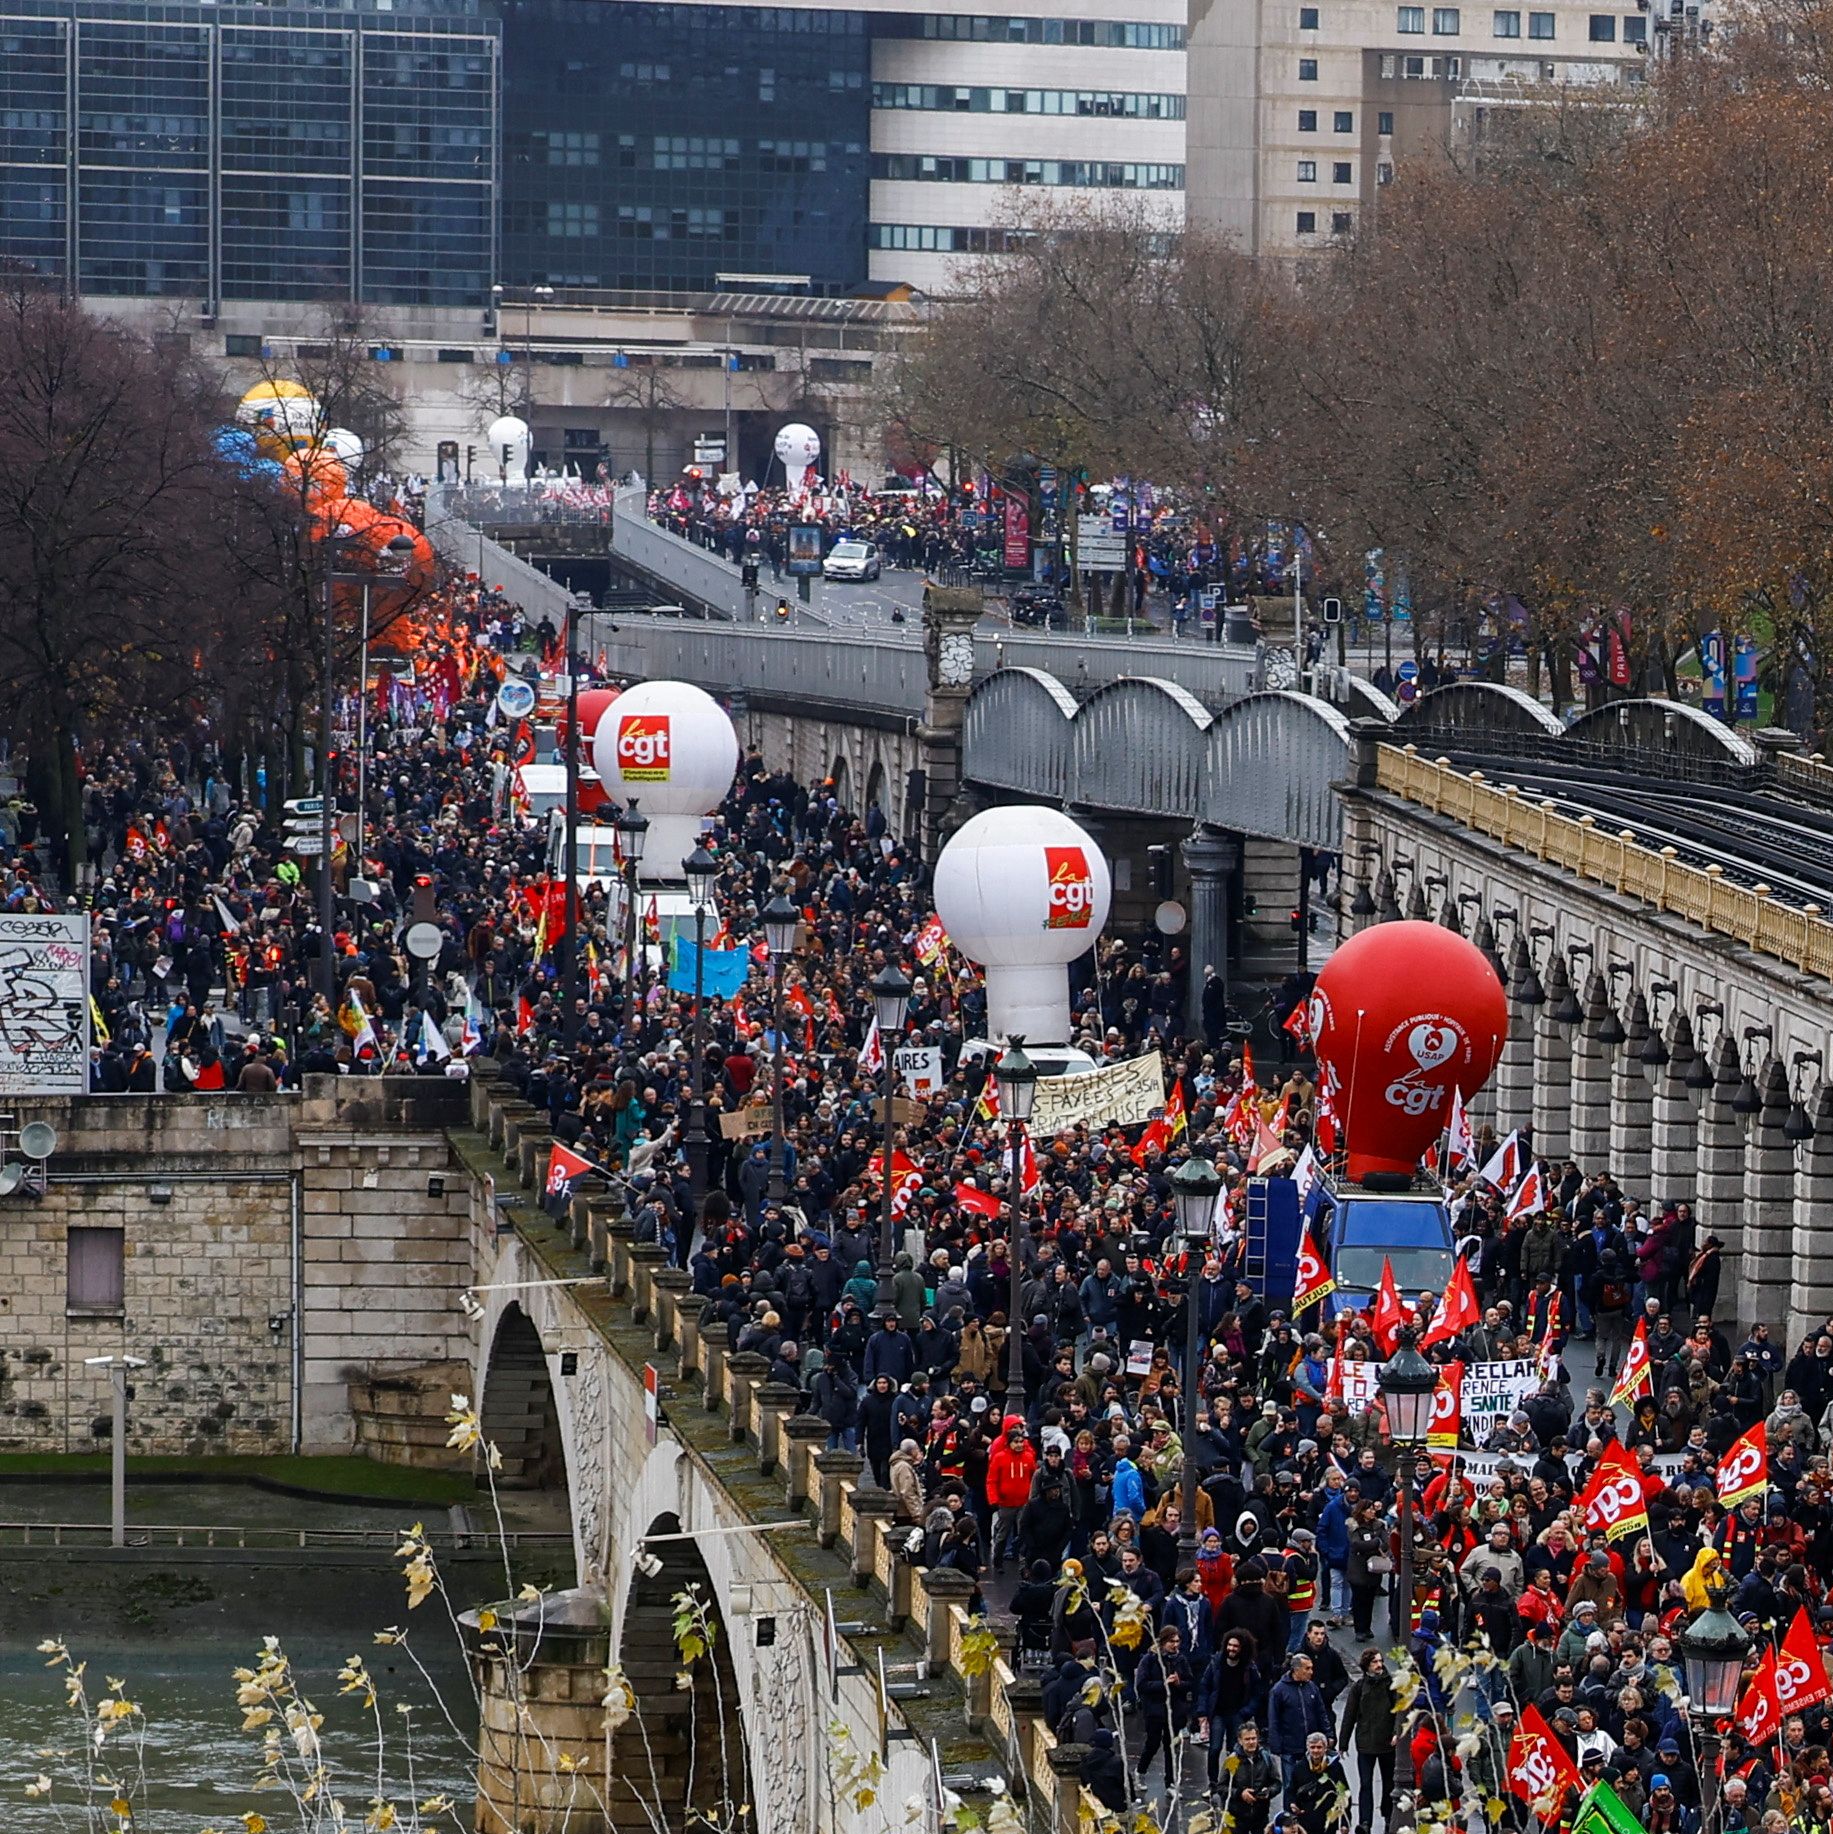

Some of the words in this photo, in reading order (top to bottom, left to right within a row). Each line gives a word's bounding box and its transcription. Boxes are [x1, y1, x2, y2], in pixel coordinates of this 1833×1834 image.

[618, 729, 669, 765] cgt
[1050, 862, 1083, 882] la
[1049, 876, 1094, 913] cgt
[1409, 1012, 1440, 1025] PUBLIQUE
[1416, 1050, 1446, 1062] USAP
[1393, 1067, 1432, 1090] la
[1384, 1083, 1446, 1116] cgt
